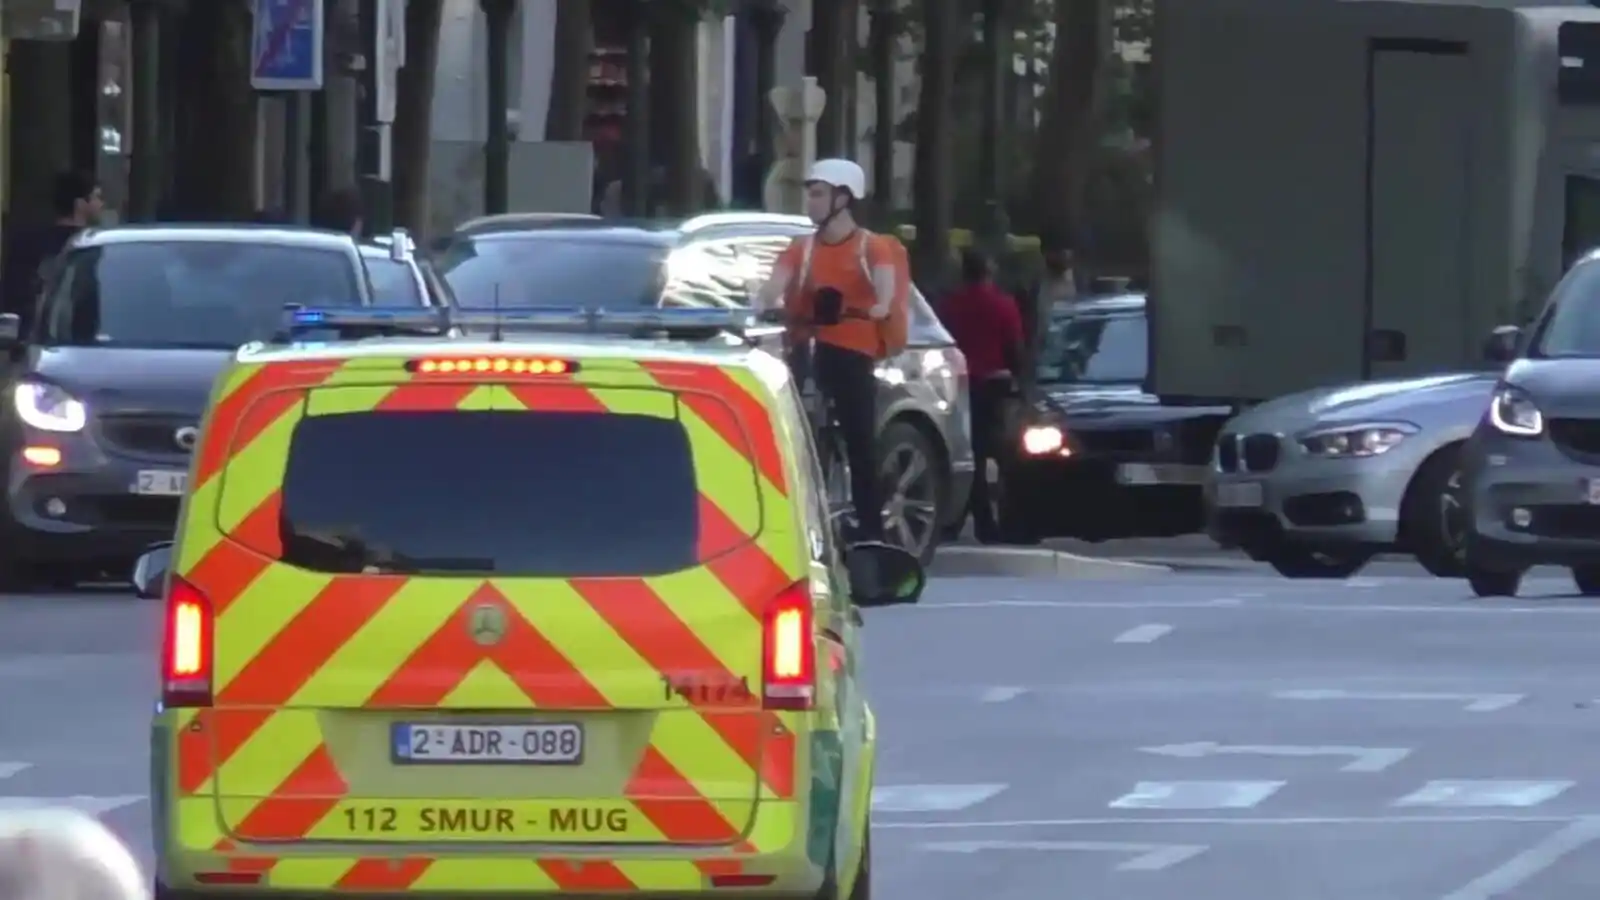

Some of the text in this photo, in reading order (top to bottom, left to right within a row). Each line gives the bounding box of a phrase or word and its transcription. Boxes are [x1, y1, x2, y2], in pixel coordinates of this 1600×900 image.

[344, 807, 398, 832] 112
[418, 807, 515, 832] SMUR
[549, 807, 628, 832] MUG
